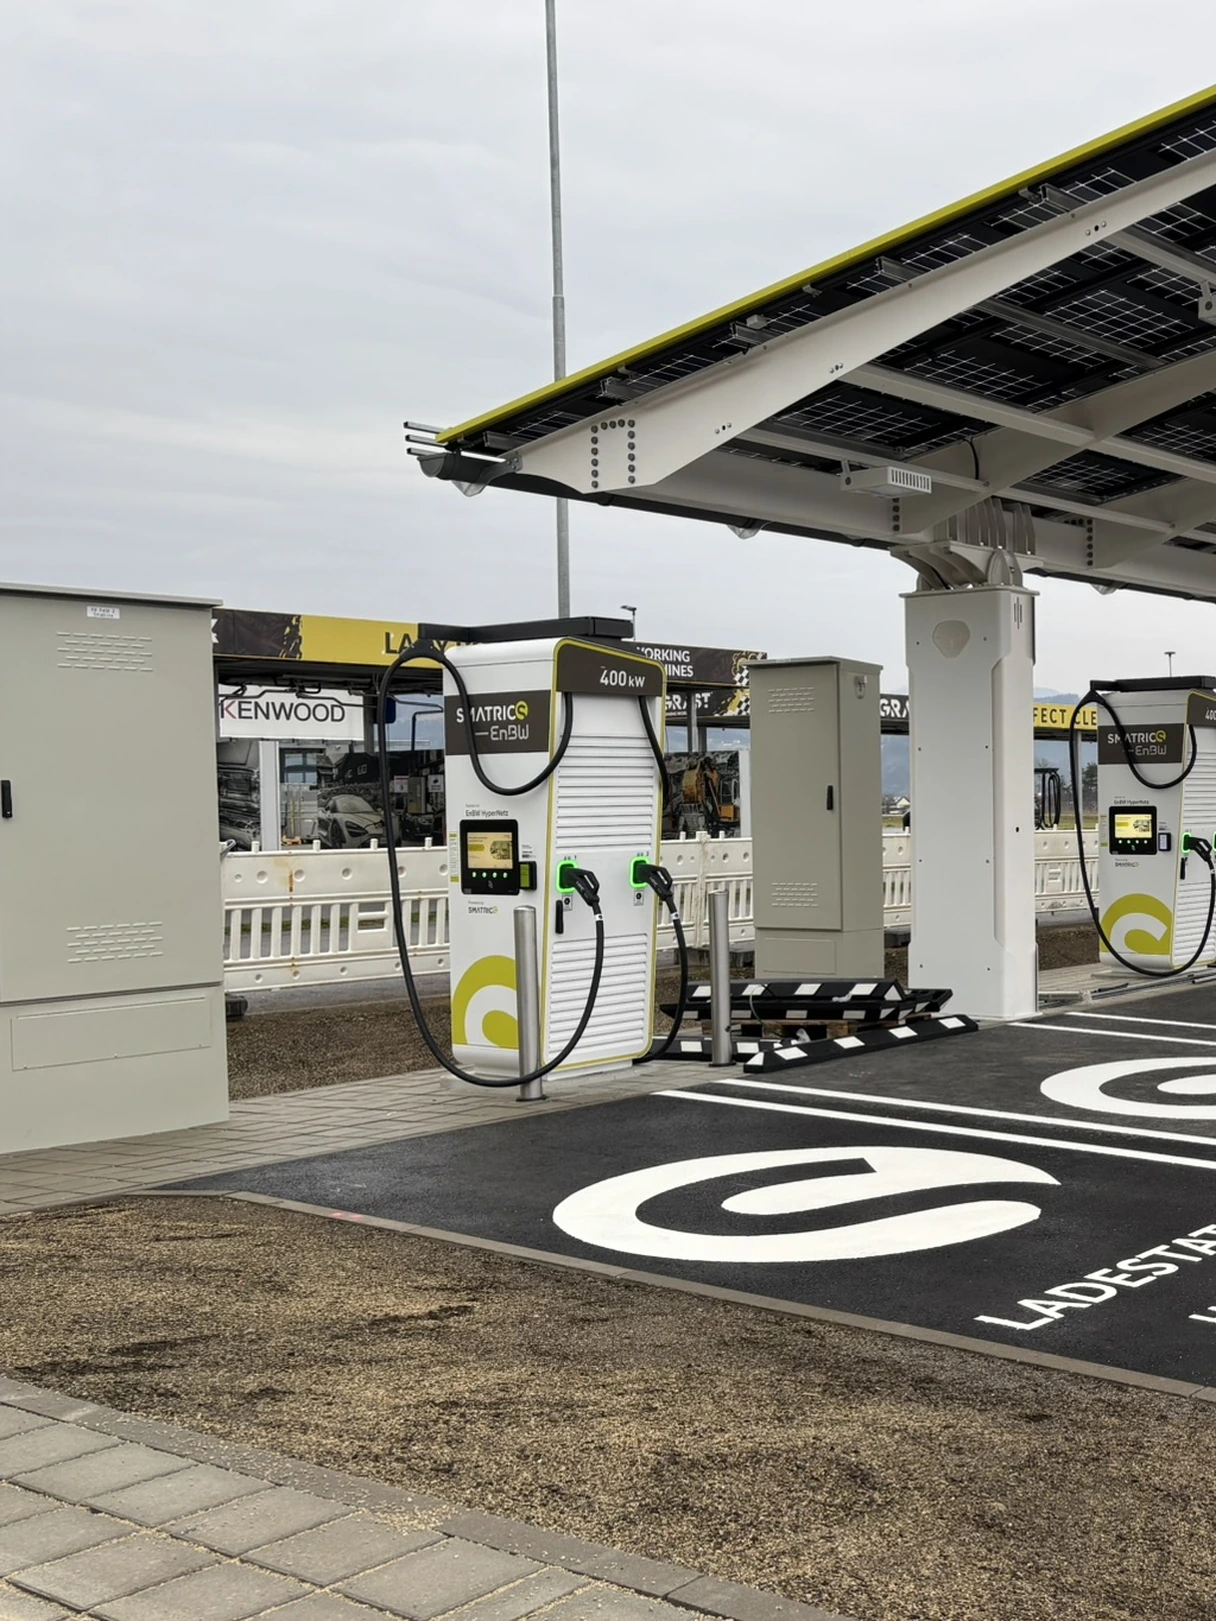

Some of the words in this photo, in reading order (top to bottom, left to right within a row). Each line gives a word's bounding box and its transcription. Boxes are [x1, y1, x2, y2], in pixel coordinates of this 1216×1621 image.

[637, 647, 691, 662] ORKING
[600, 671, 627, 687] 400
[628, 676, 646, 688] kW
[220, 700, 346, 722] KENWOOD
[490, 724, 530, 741] EnBW
[1135, 745, 1167, 756] EnBW
